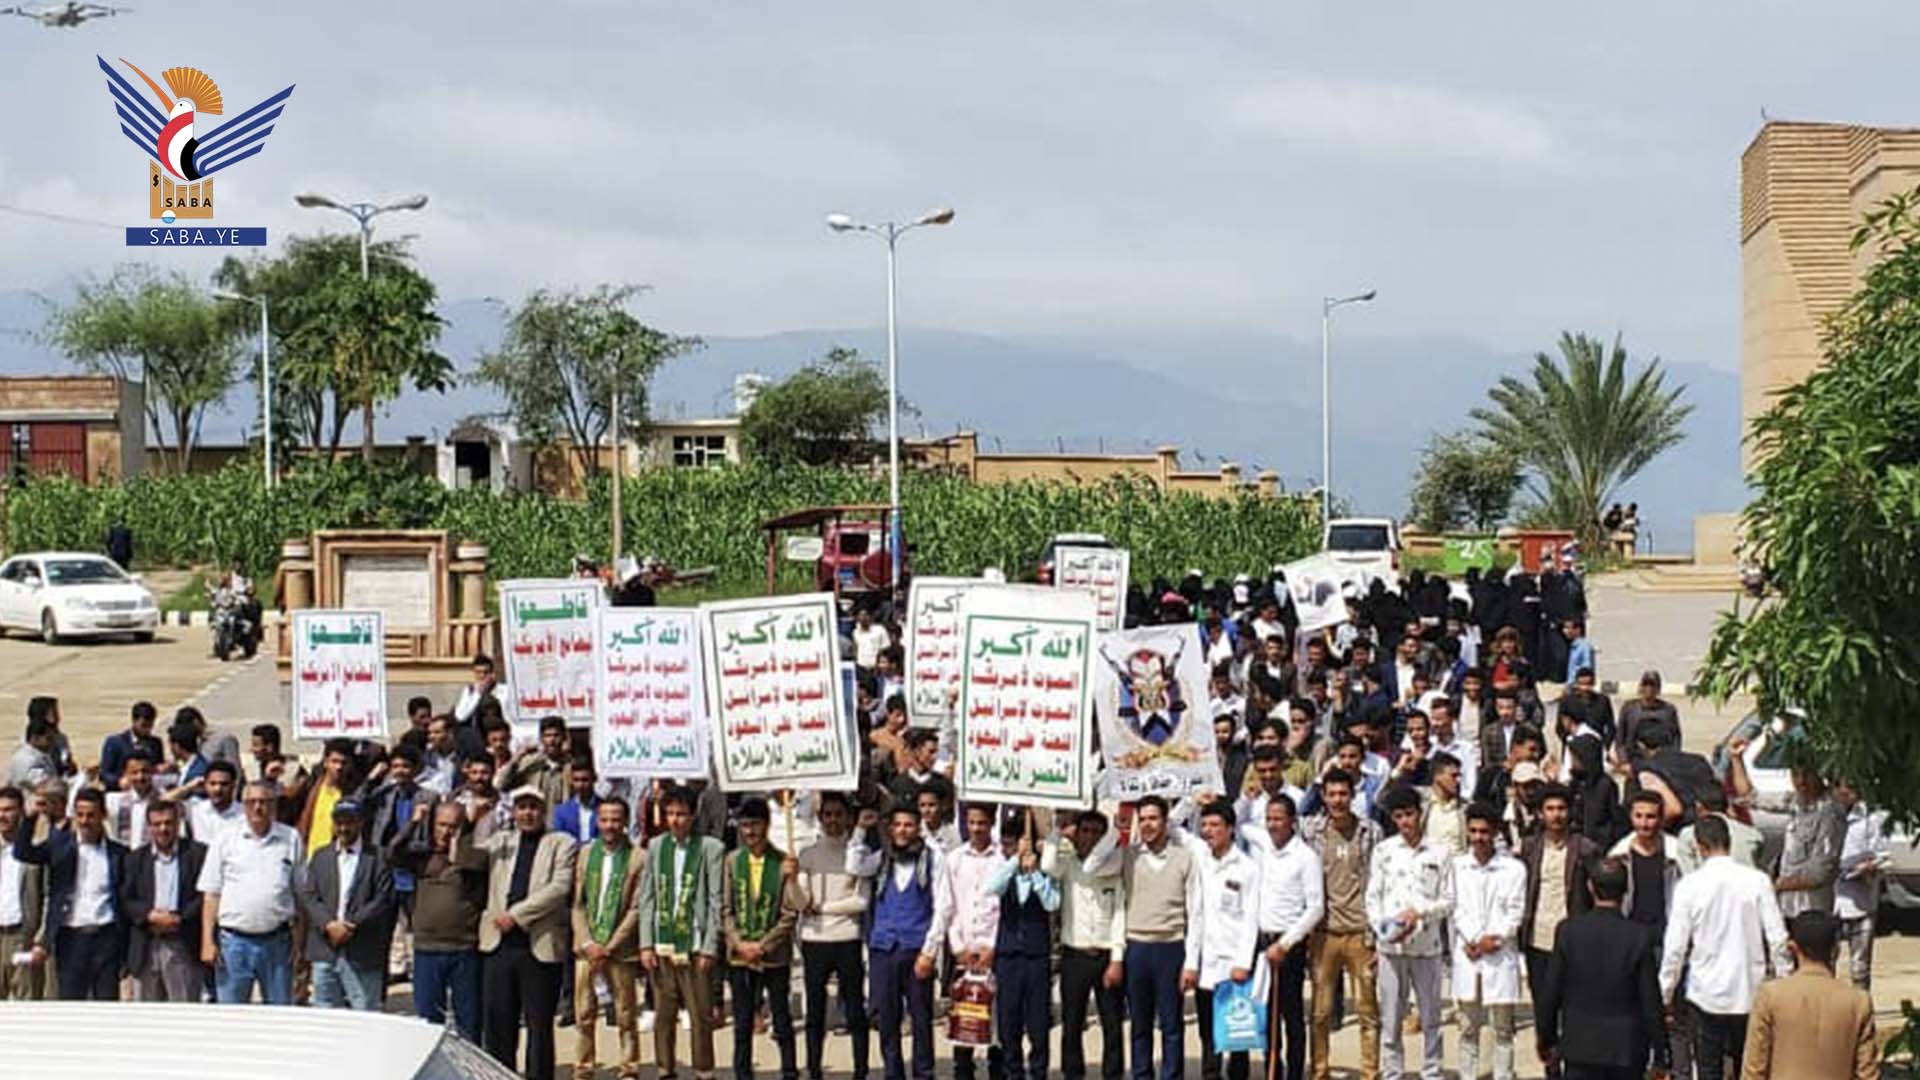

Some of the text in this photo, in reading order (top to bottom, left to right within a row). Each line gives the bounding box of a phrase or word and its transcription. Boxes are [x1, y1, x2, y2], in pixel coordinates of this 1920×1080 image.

[511, 592, 589, 628] قاطعوا
[657, 619, 690, 646] الله
[784, 612, 825, 641] الله
[1041, 629, 1084, 660] الله
